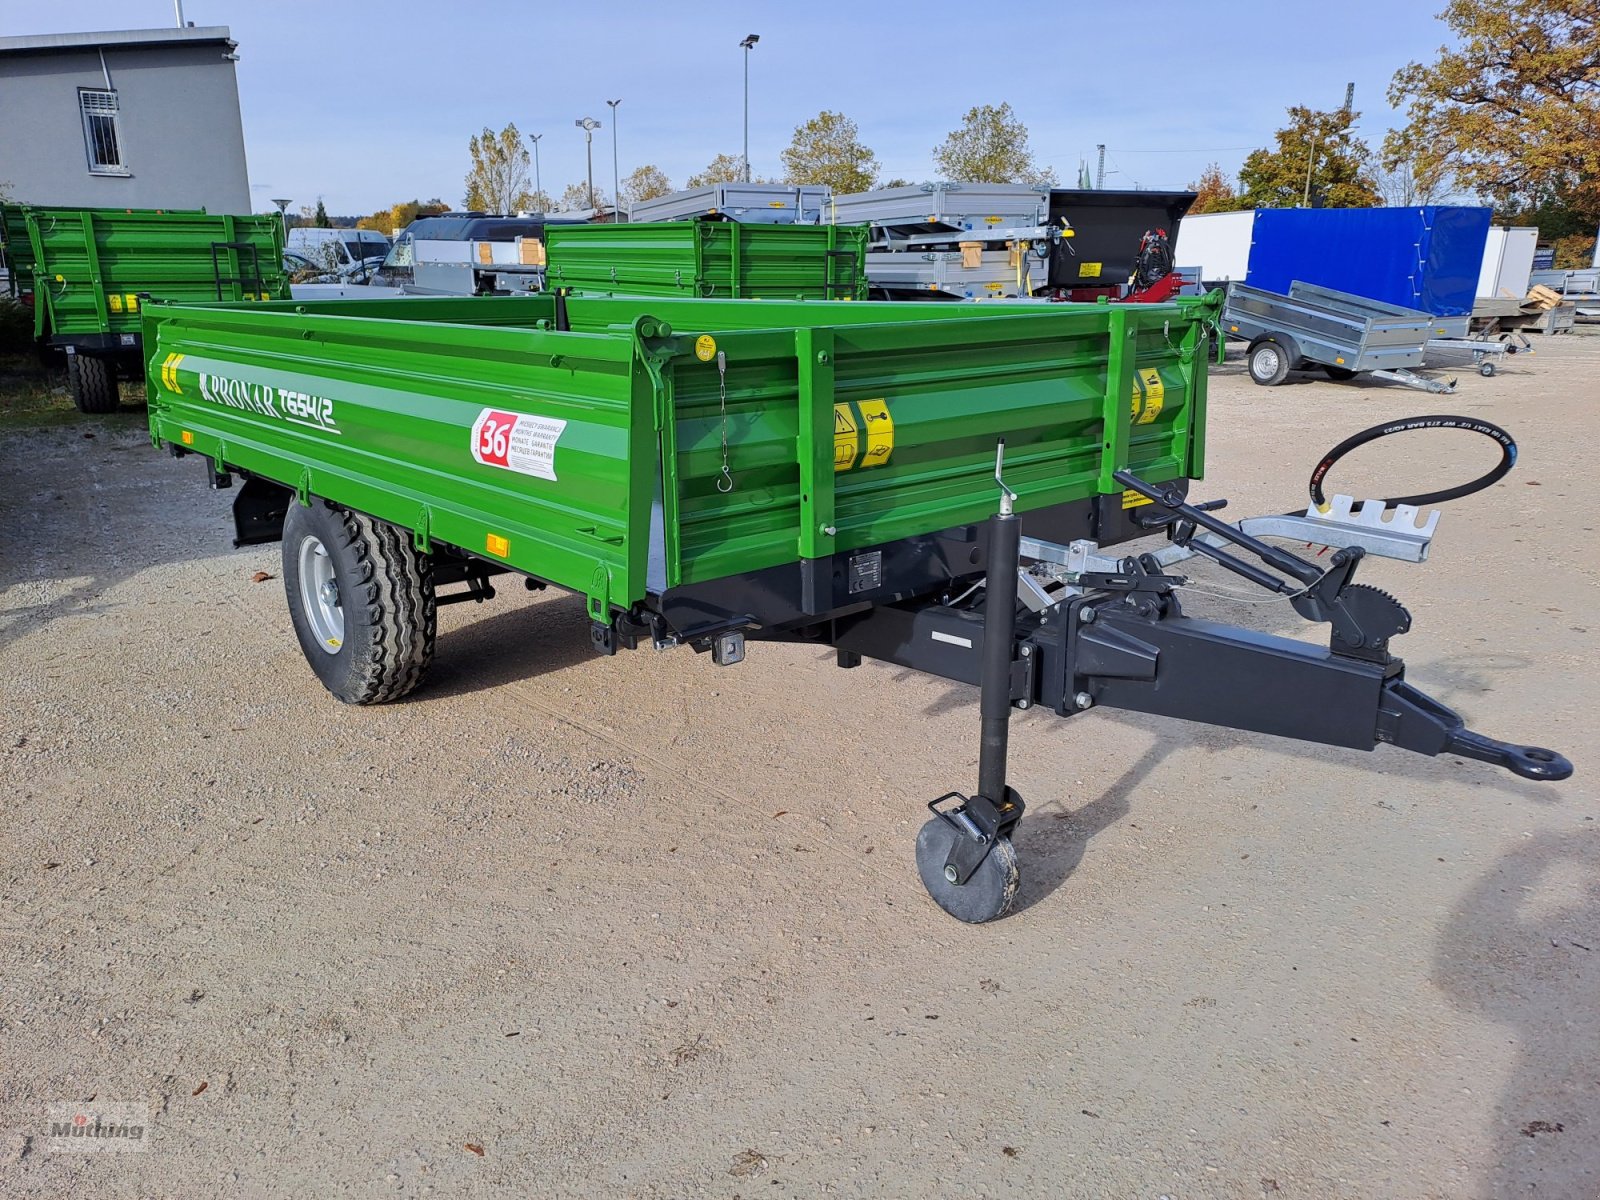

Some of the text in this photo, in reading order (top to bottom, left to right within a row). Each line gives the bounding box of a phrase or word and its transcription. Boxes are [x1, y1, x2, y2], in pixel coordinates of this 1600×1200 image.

[211, 375, 336, 428] PRONAR T654/2
[480, 419, 511, 458] 36
